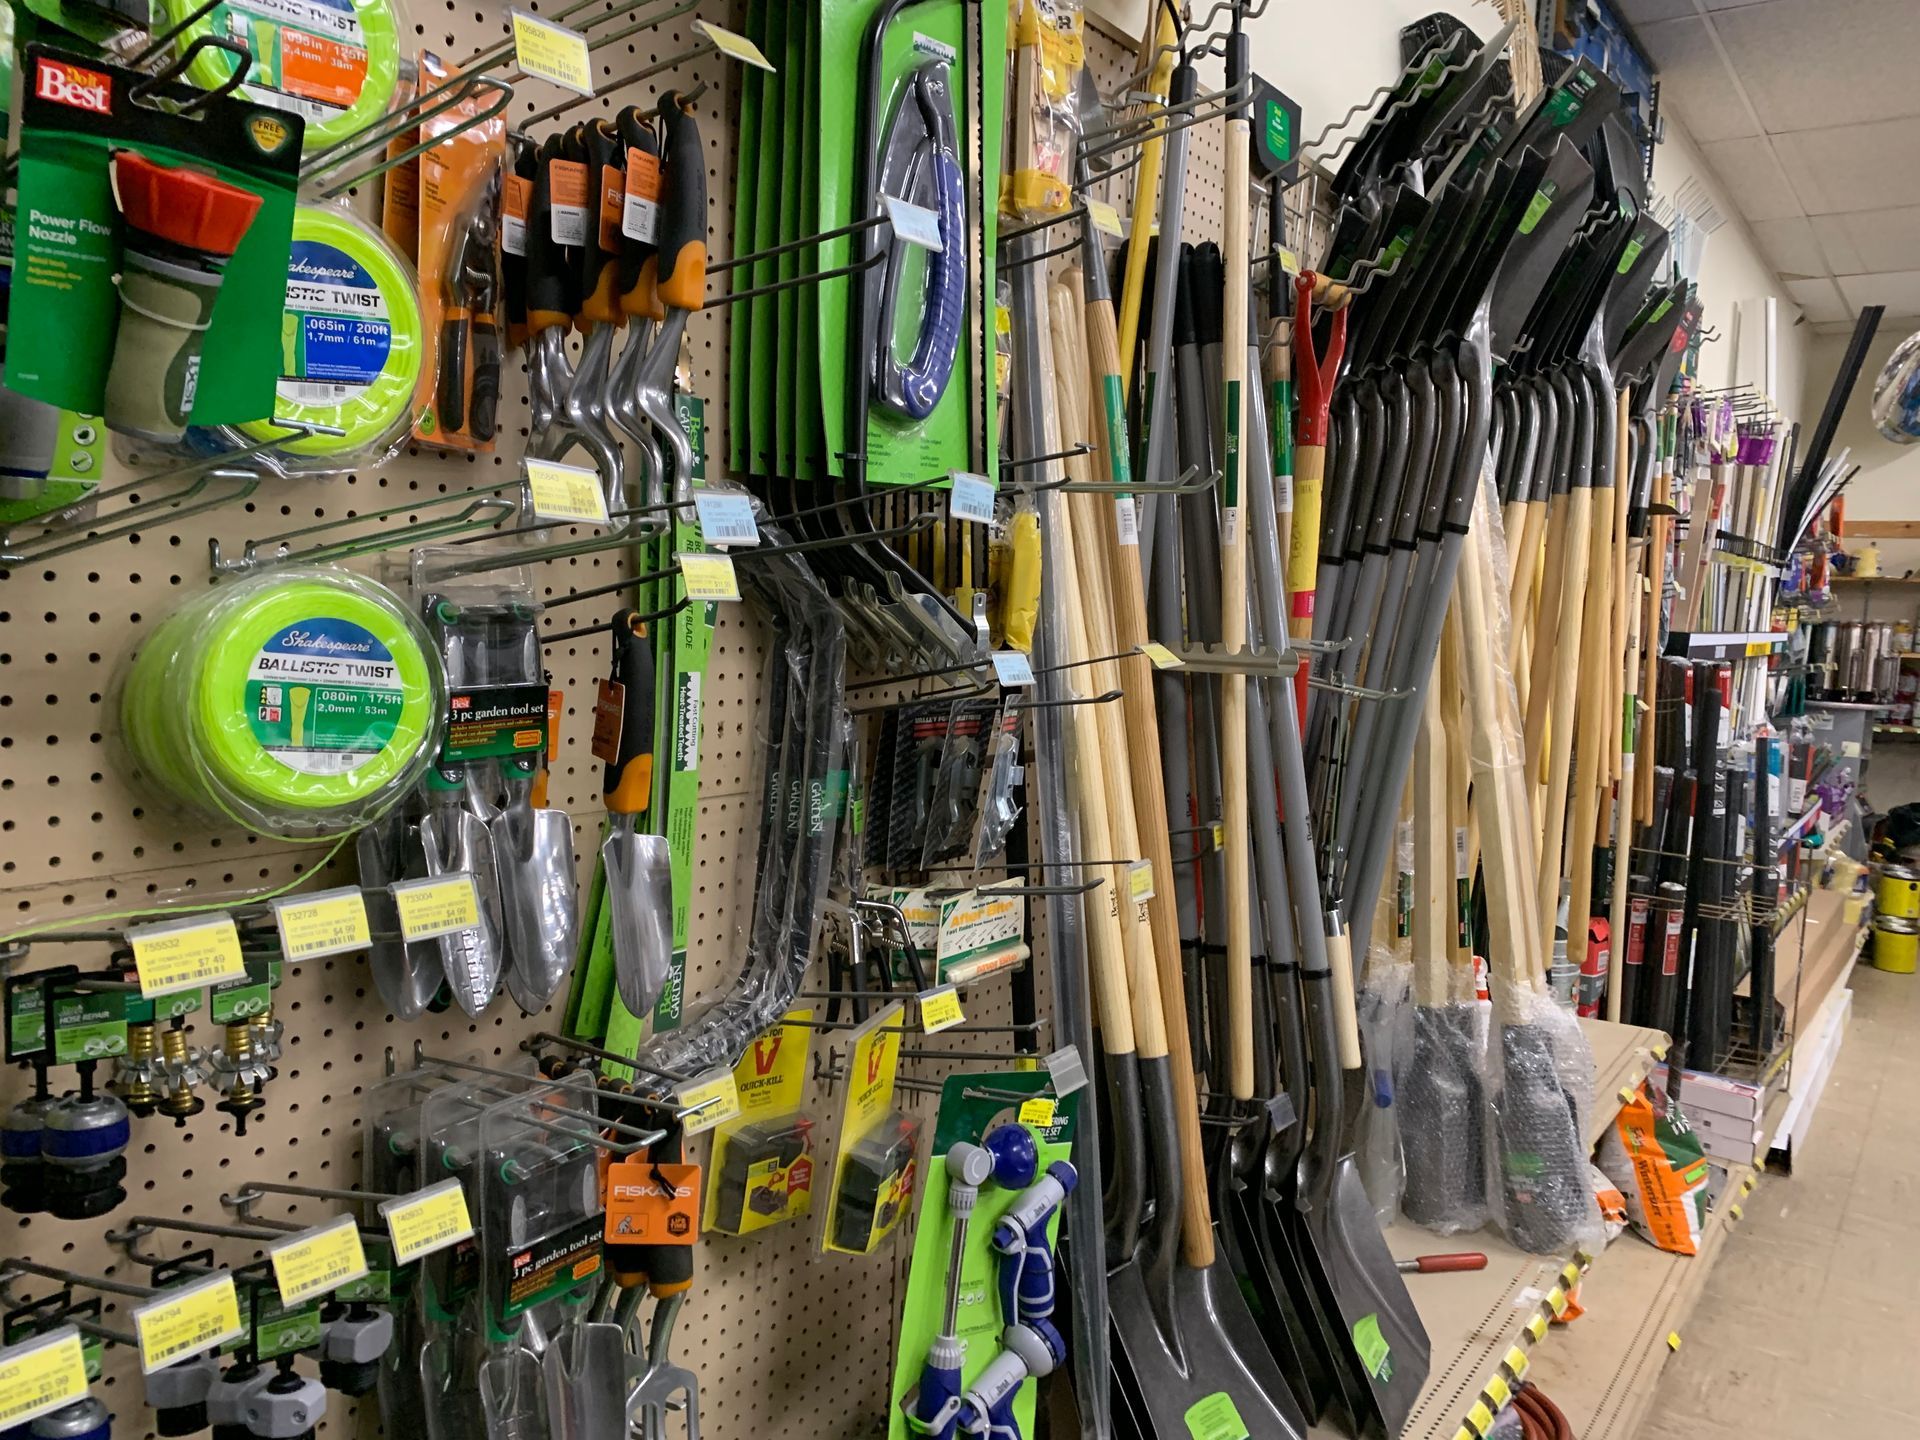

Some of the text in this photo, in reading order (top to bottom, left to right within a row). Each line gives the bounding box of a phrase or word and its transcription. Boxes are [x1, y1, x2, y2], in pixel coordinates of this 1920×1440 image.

[309, 7, 357, 32] TWIST
[151, 55, 171, 76] ASS
[40, 66, 108, 110] Best
[258, 121, 281, 132] FREE
[30, 209, 111, 236] Power Flow
[29, 225, 77, 245] Nozzle
[331, 291, 380, 308] TWIST
[306, 319, 346, 332] .065in
[357, 324, 389, 336] 200ft
[307, 332, 344, 344] 1,7mm
[353, 335, 377, 346] 61m
[282, 630, 370, 654] Shakespeare
[686, 616, 694, 650] BLADE
[258, 658, 394, 679] BALLISTIC TWIST
[318, 691, 357, 702] .080in
[368, 693, 402, 705] 175ft
[452, 699, 470, 709] Best
[365, 706, 387, 715] 53m
[451, 703, 544, 722] 3 pc garden tool set
[677, 686, 687, 761] Heat-Treated Teeth
[690, 716, 698, 747] Cutting
[811, 782, 823, 832] GARDEN
[287, 908, 318, 921] 732728
[950, 901, 1013, 928] After Bite
[946, 927, 958, 936] Fast
[959, 922, 974, 932] Relief
[977, 953, 1018, 974] After Bite
[659, 981, 672, 1015] Best
[671, 965, 682, 1019] GARDEN
[60, 1011, 110, 1024] HOSE REPAIR
[741, 1075, 784, 1092] QUICK-KILL
[1050, 1127, 1062, 1136] SET
[1638, 1159, 1662, 1217] Winterizer
[512, 1230, 603, 1280] 3 pc garden tool set
